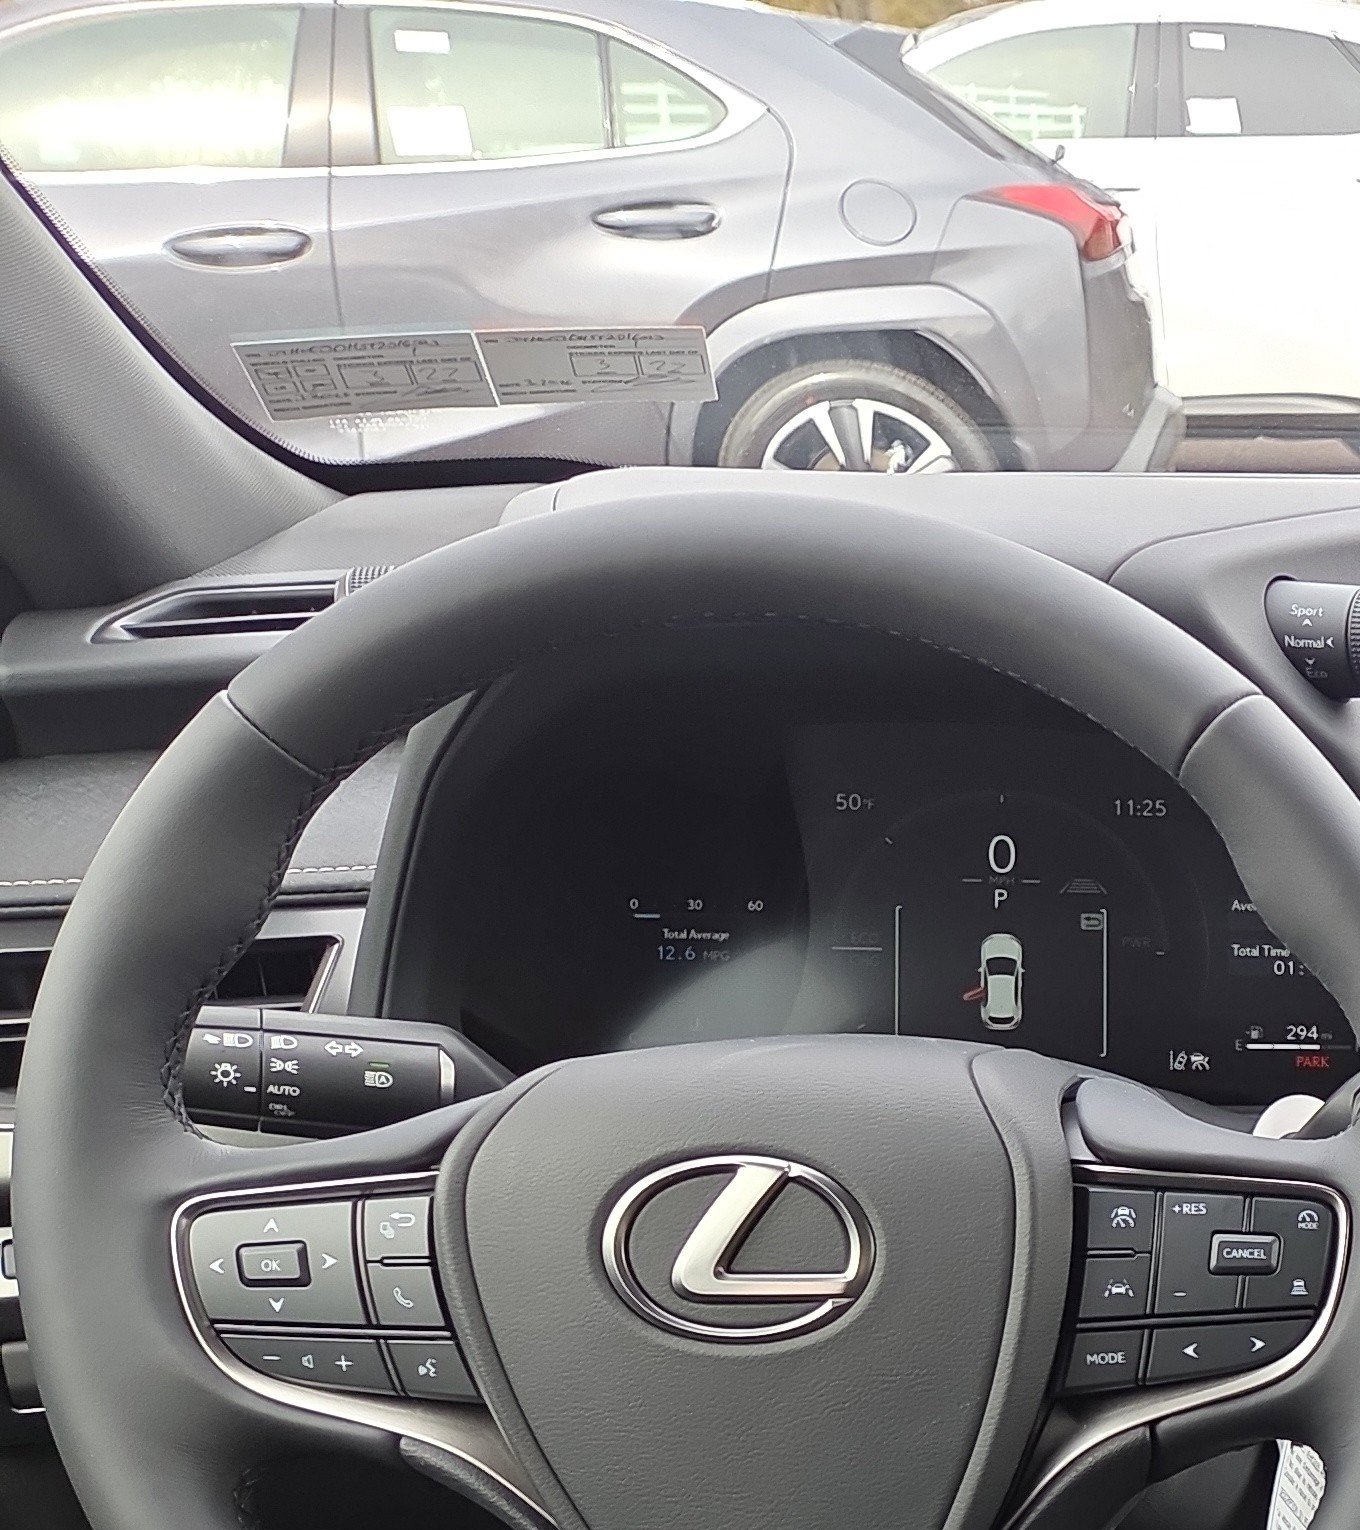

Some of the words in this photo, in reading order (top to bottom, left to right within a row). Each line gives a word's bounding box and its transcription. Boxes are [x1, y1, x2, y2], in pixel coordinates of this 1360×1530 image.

[1289, 604, 1324, 618] Sport
[1284, 635, 1326, 649] Normal
[1114, 800, 1167, 818] 11:25
[988, 834, 1016, 874] 0
[629, 899, 639, 910] 0
[687, 900, 703, 911] 30
[747, 900, 763, 912] 60
[994, 889, 1008, 909] P
[662, 928, 687, 940] Total
[688, 928, 730, 943] Average
[657, 945, 696, 961] 12.6
[1231, 944, 1260, 958] Total
[1262, 945, 1290, 958] Time
[1286, 1026, 1318, 1041] 294
[1236, 1039, 1243, 1051] E
[1295, 1055, 1330, 1068] PARK
[266, 1084, 301, 1097] AUTO
[1298, 1222, 1319, 1230] MODE
[1222, 1247, 1268, 1260] CANCEL
[261, 1259, 281, 1272] OK
[1086, 1351, 1127, 1365] MODE
